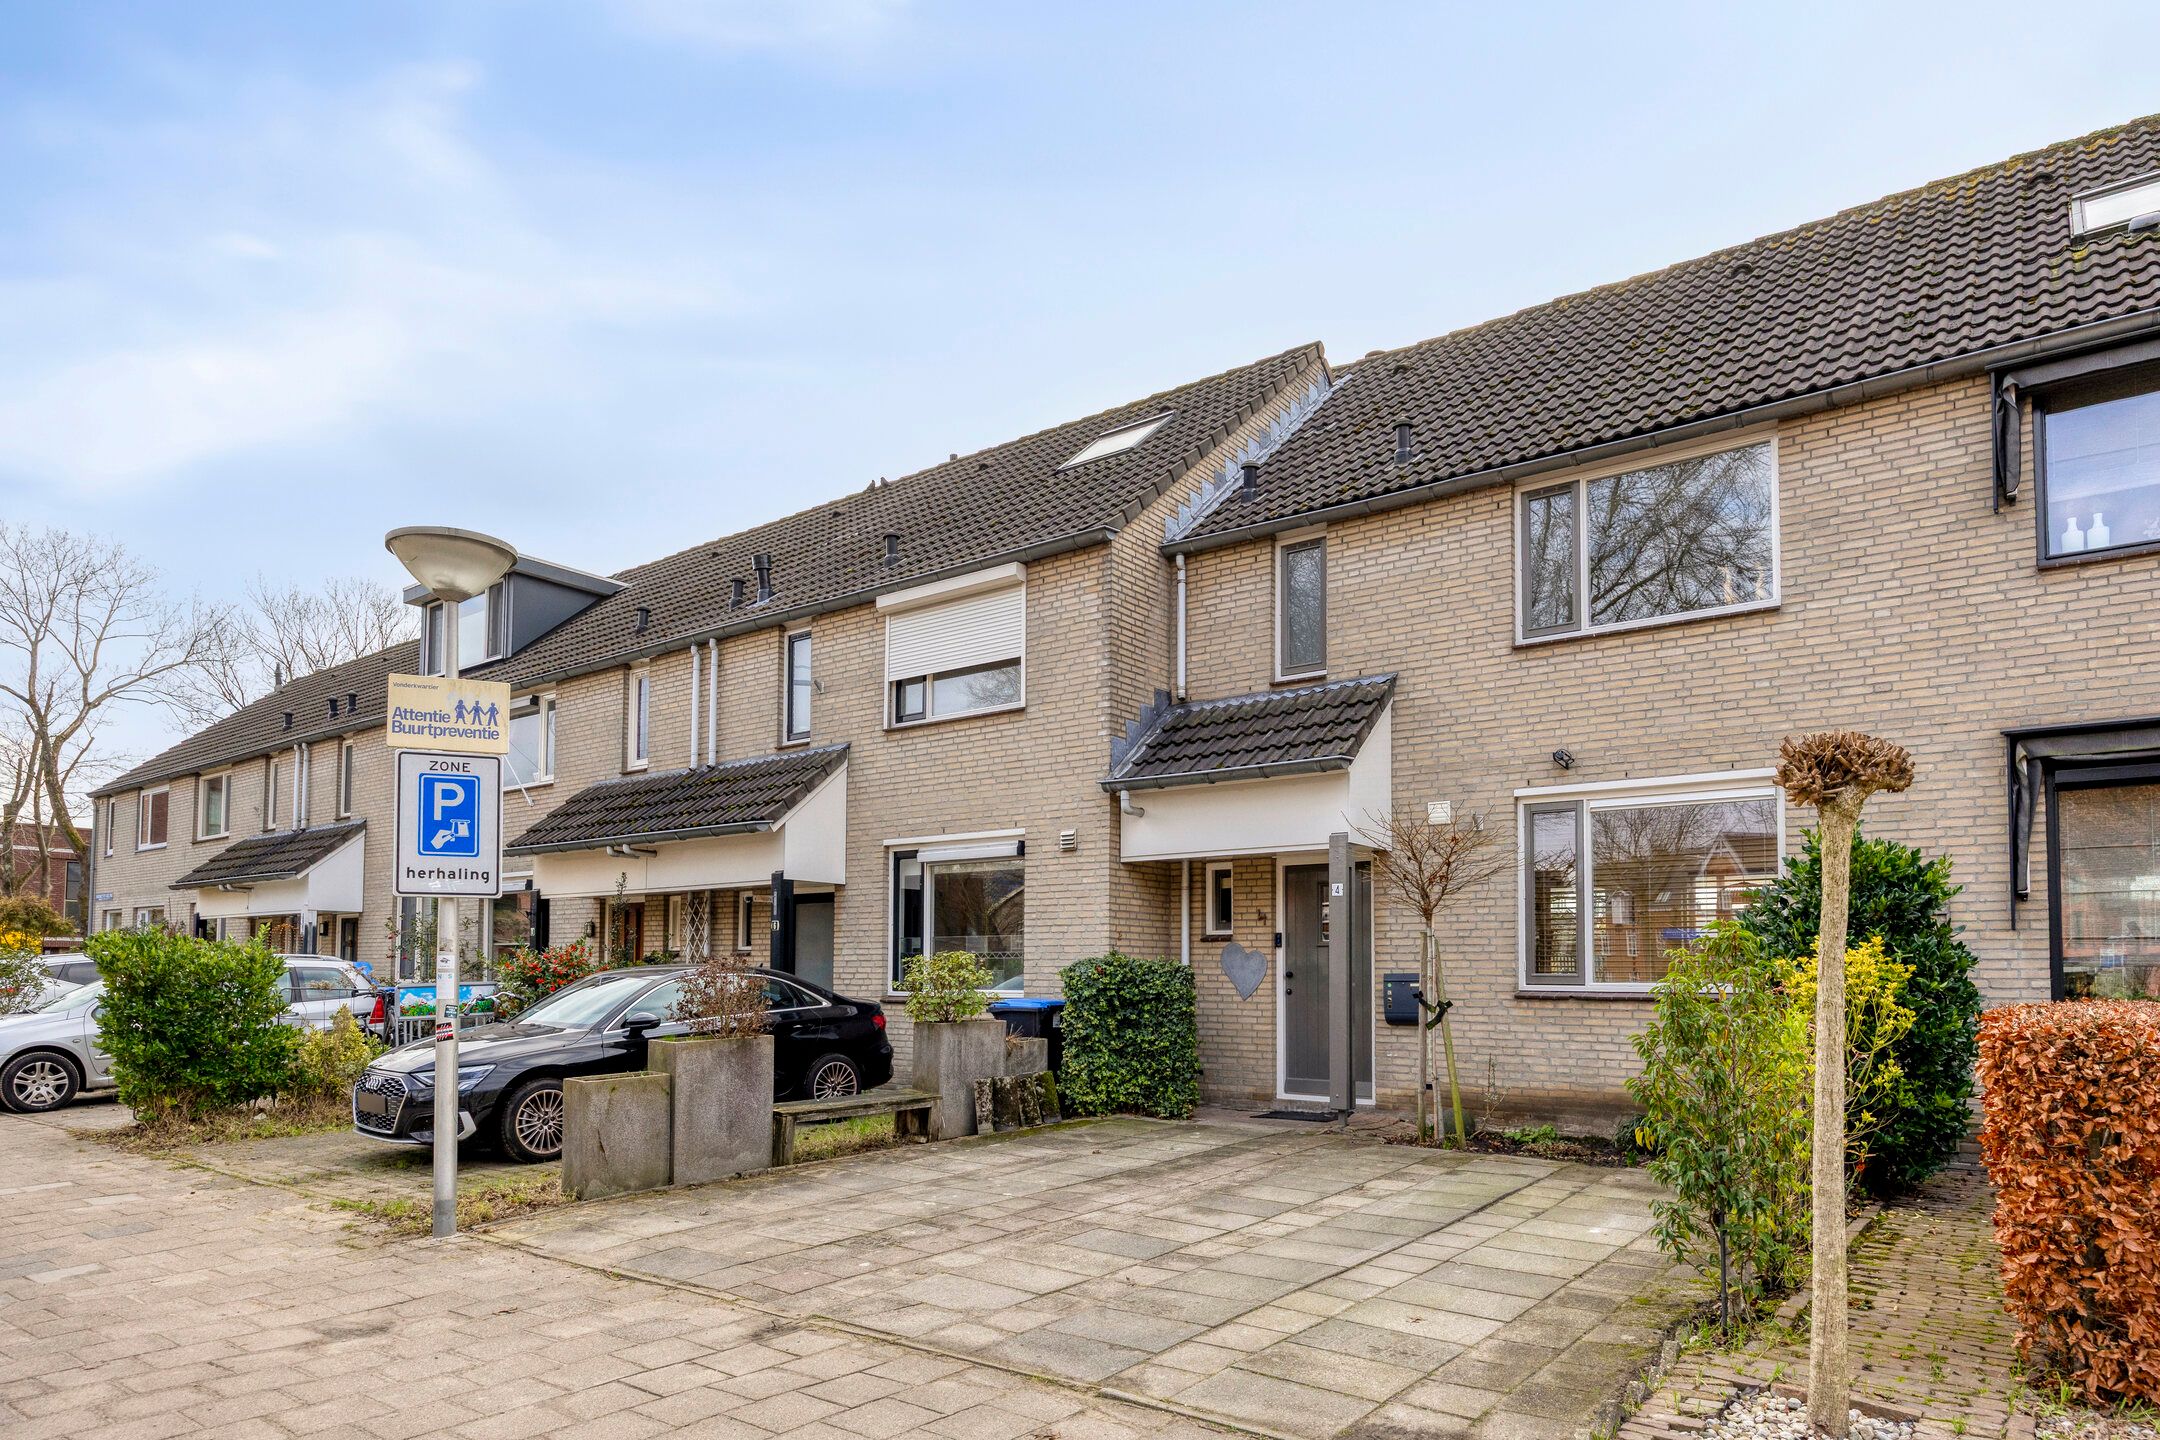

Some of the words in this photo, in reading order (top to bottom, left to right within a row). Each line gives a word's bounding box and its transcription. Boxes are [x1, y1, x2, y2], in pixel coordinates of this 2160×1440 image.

[392, 706, 451, 723] Attentie
[391, 719, 500, 740] Buurtpreventie
[429, 760, 471, 773] ZONE
[433, 781, 465, 821] P
[406, 867, 490, 884] herhaling
